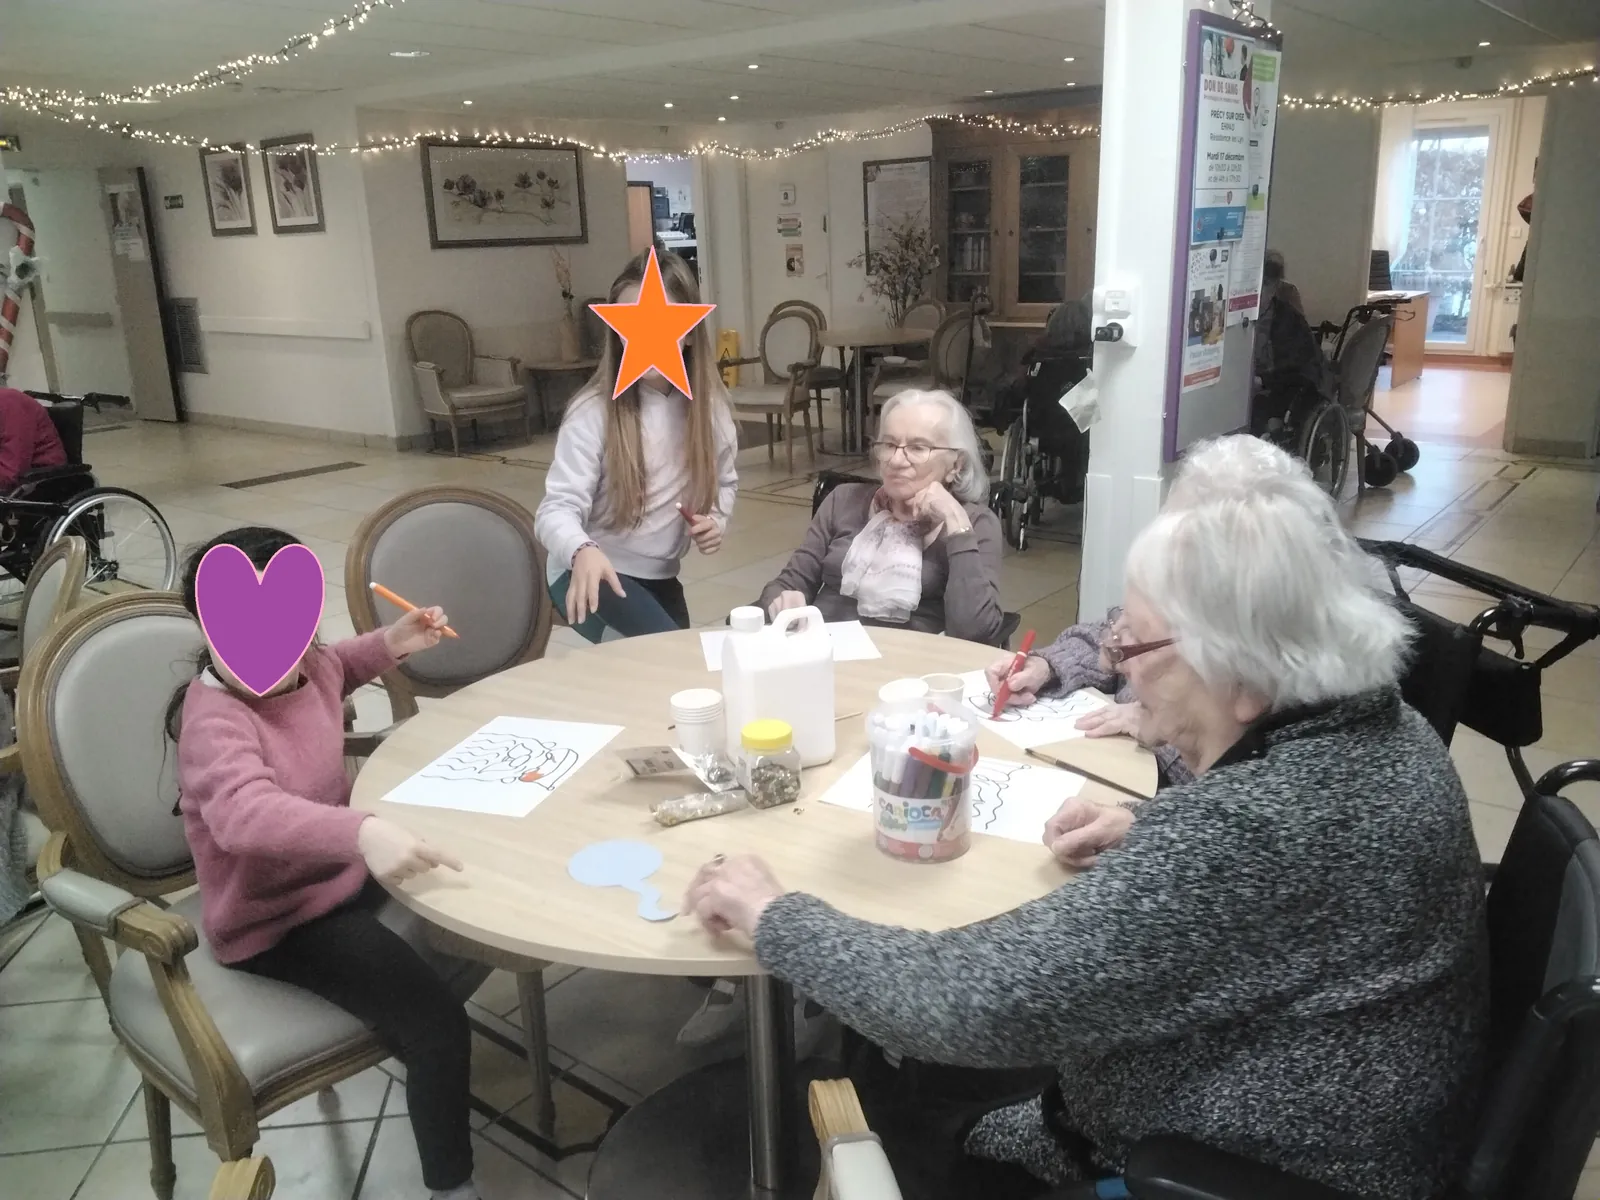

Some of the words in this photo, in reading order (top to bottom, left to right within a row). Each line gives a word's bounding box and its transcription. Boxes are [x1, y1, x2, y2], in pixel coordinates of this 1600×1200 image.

[1204, 79, 1216, 93] DON
[1217, 81, 1224, 93] DE
[1225, 82, 1238, 95] SANG
[1211, 109, 1225, 119] PRÉCY
[1226, 111, 1235, 120] SUR
[1235, 112, 1244, 121] OISE
[1207, 152, 1219, 160] Mardi
[1220, 152, 1225, 160] 17
